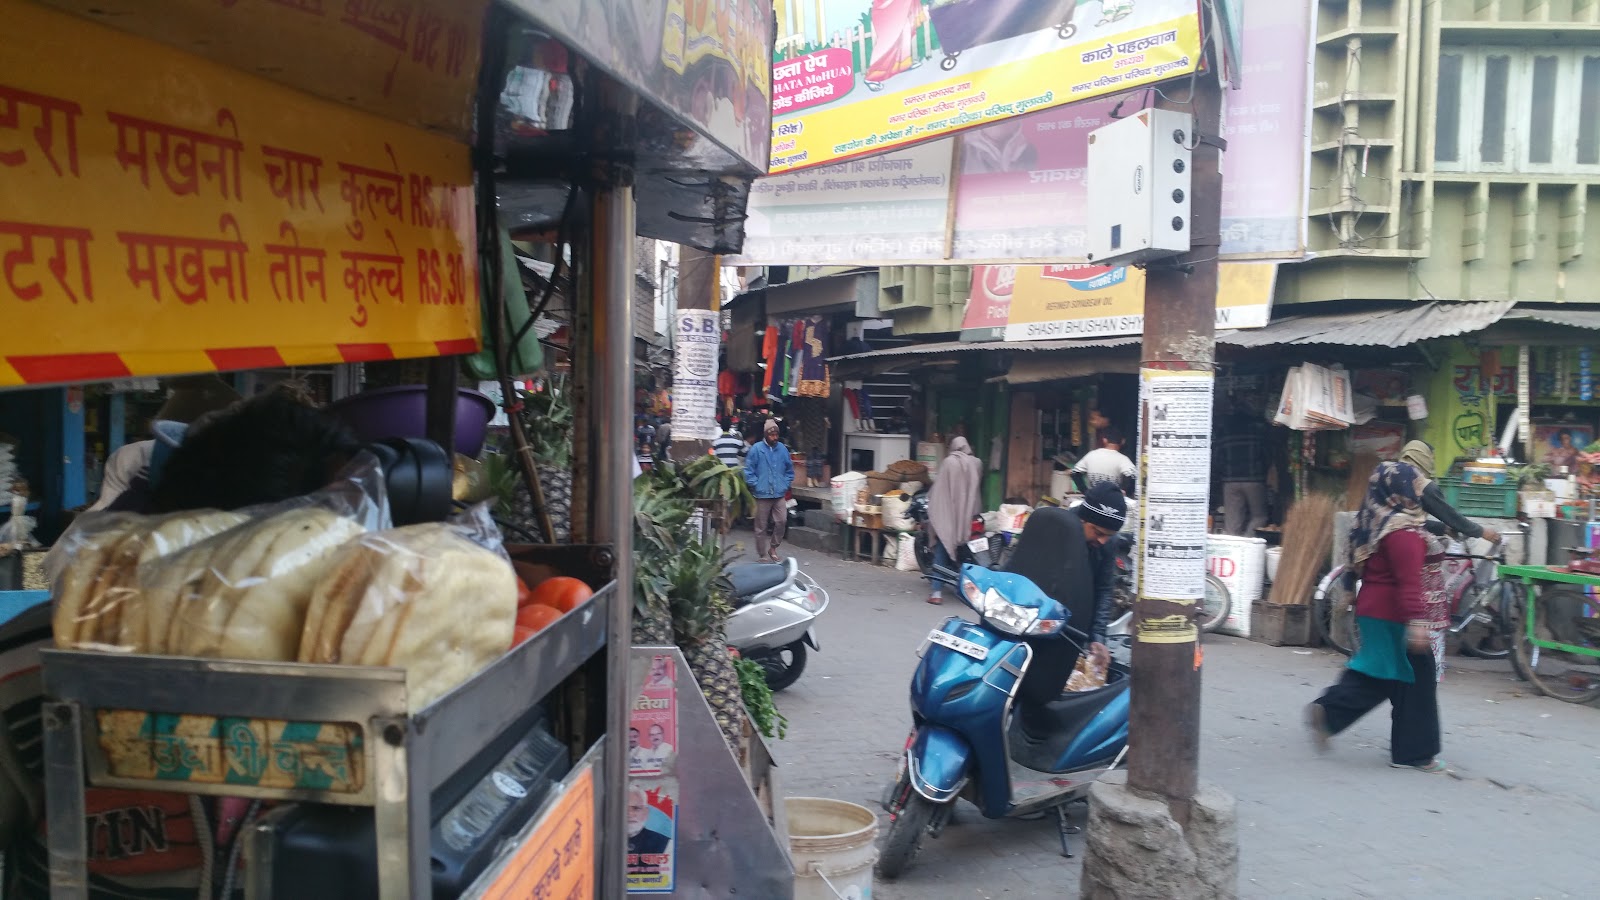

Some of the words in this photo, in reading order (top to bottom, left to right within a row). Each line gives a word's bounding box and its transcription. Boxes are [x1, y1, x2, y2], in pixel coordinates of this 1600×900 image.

[1082, 43, 1114, 63] काले
[1117, 30, 1177, 54] पहलवान
[773, 62, 801, 80] छता
[804, 54, 828, 73] ऐप
[774, 79, 805, 94] HATA
[806, 66, 852, 85] MoHUA)
[773, 94, 793, 111] लोड
[795, 83, 834, 103] कीजिये
[834, 139, 863, 154] सहयोग
[865, 134, 877, 146] की
[0, 84, 83, 178] टरा
[107, 108, 244, 202] मखनी
[261, 144, 325, 213] चार
[337, 142, 403, 241] कुल्चे
[0, 221, 94, 304] टरा
[117, 213, 249, 305] मखनी
[265, 220, 326, 303] तीन
[341, 230, 404, 327] कुल्चे
[417, 247, 466, 306] RS.30
[1027, 322, 1063, 337] SHASHI
[1065, 318, 1118, 334] BHUSHAN
[1120, 316, 1144, 331] SHY
